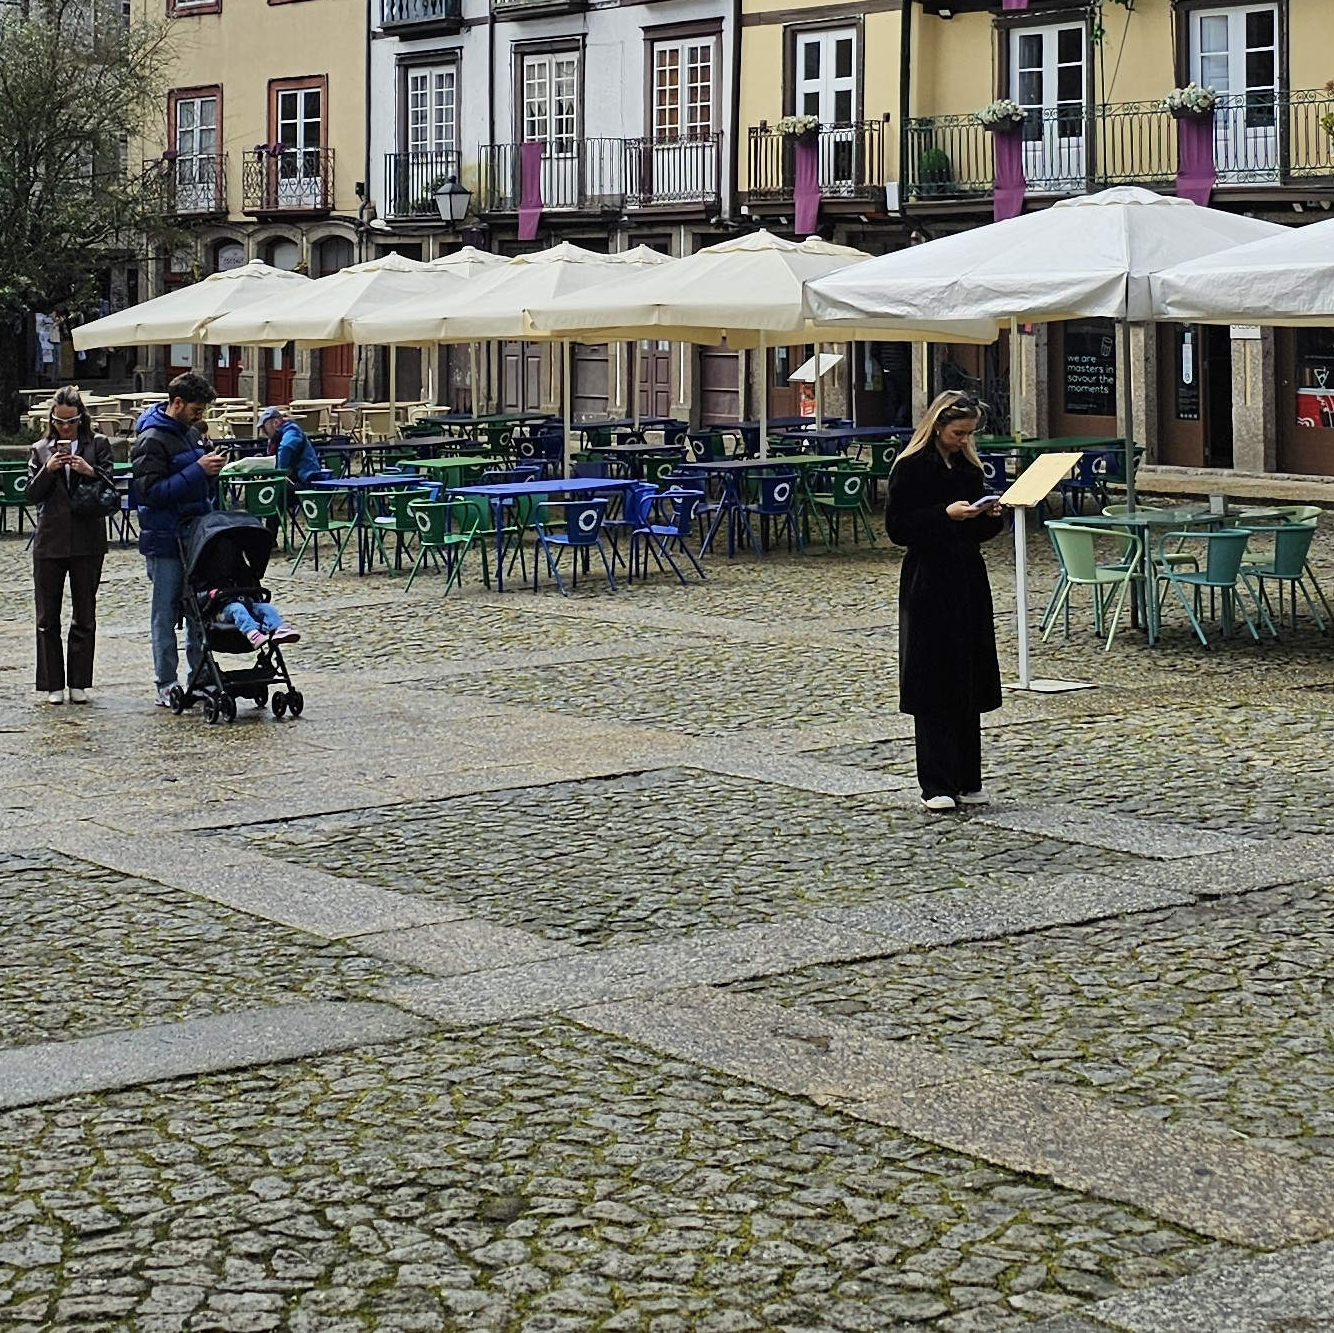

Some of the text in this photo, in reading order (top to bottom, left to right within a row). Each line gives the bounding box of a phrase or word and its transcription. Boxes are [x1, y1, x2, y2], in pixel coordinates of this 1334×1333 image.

[1067, 355, 1079, 363] we
[1067, 364, 1114, 373] masters in
[1067, 374, 1114, 384] savour the
[1067, 385, 1108, 393] moments
